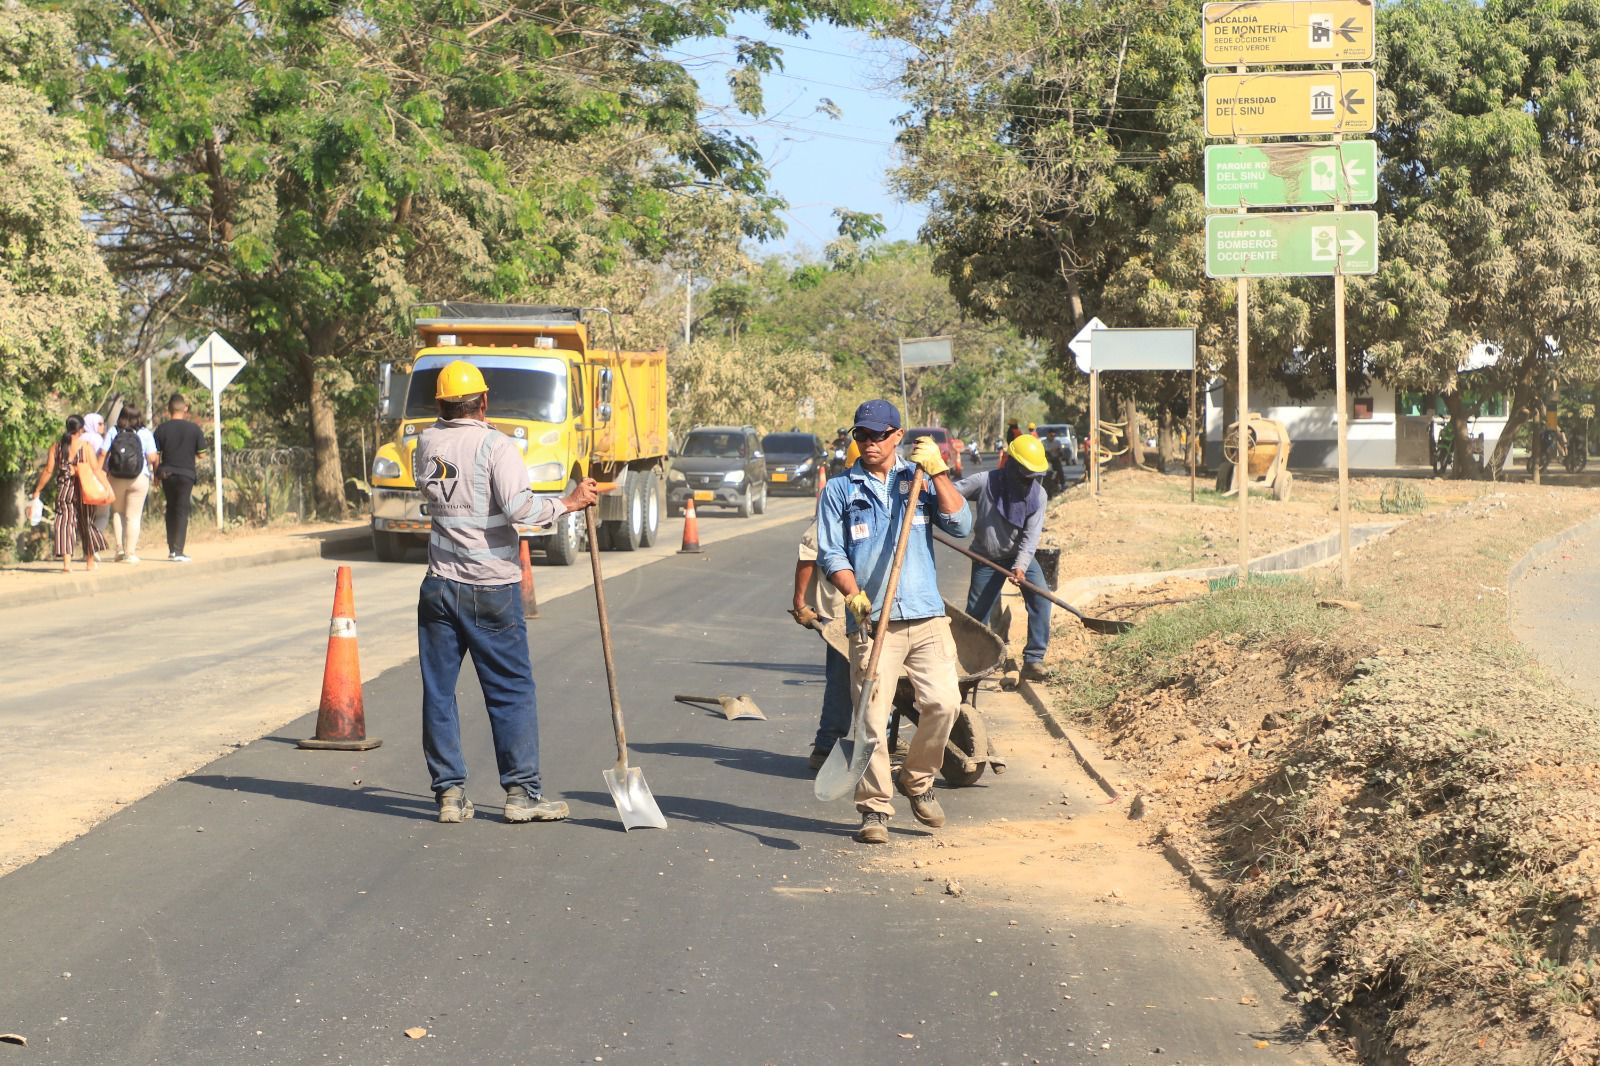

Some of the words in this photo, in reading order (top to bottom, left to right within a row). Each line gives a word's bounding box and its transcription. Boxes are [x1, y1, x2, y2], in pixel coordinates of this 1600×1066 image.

[1214, 26, 1229, 35] DE
[1235, 36, 1277, 44] OCCIDENTE
[1216, 96, 1277, 105] UNIVERSIDAD
[1216, 107, 1238, 117] DEL
[1216, 161, 1254, 170] PARQUE
[1216, 172, 1238, 181] DEL
[1216, 182, 1259, 190] OCCIDENTE
[1216, 230, 1257, 239] CUERPO
[1259, 229, 1273, 238] DE
[1216, 239, 1279, 249] BOMBEROS
[1216, 250, 1279, 261] OCCIDENTE
